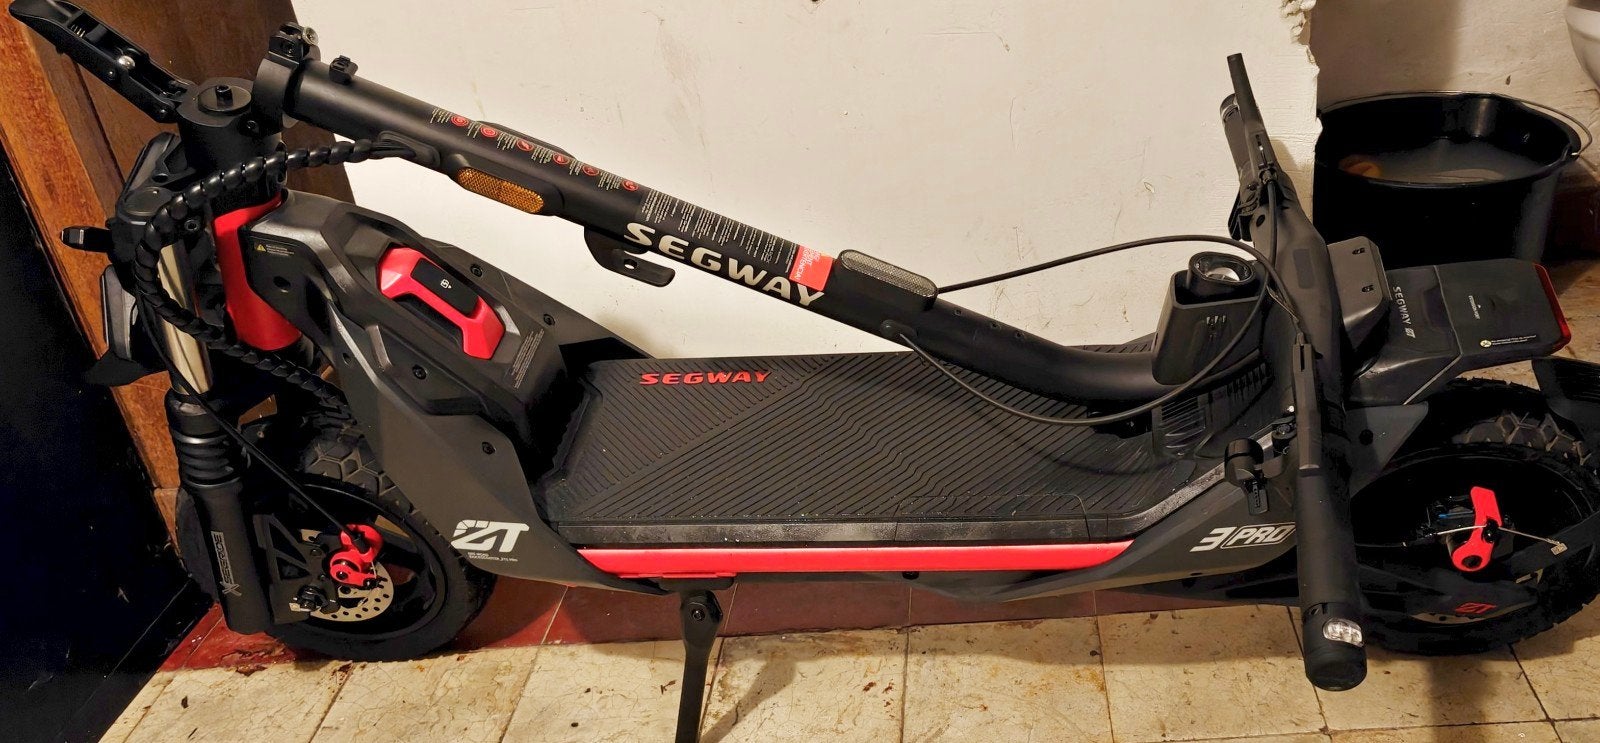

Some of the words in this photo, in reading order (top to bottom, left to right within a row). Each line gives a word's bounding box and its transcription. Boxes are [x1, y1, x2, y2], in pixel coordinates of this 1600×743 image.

[624, 222, 825, 307] SEGWAY
[1392, 286, 1412, 325] SEGWAY
[639, 370, 772, 386] SEGWAY
[1189, 526, 1238, 553] 3
[1225, 525, 1296, 547] PRO
